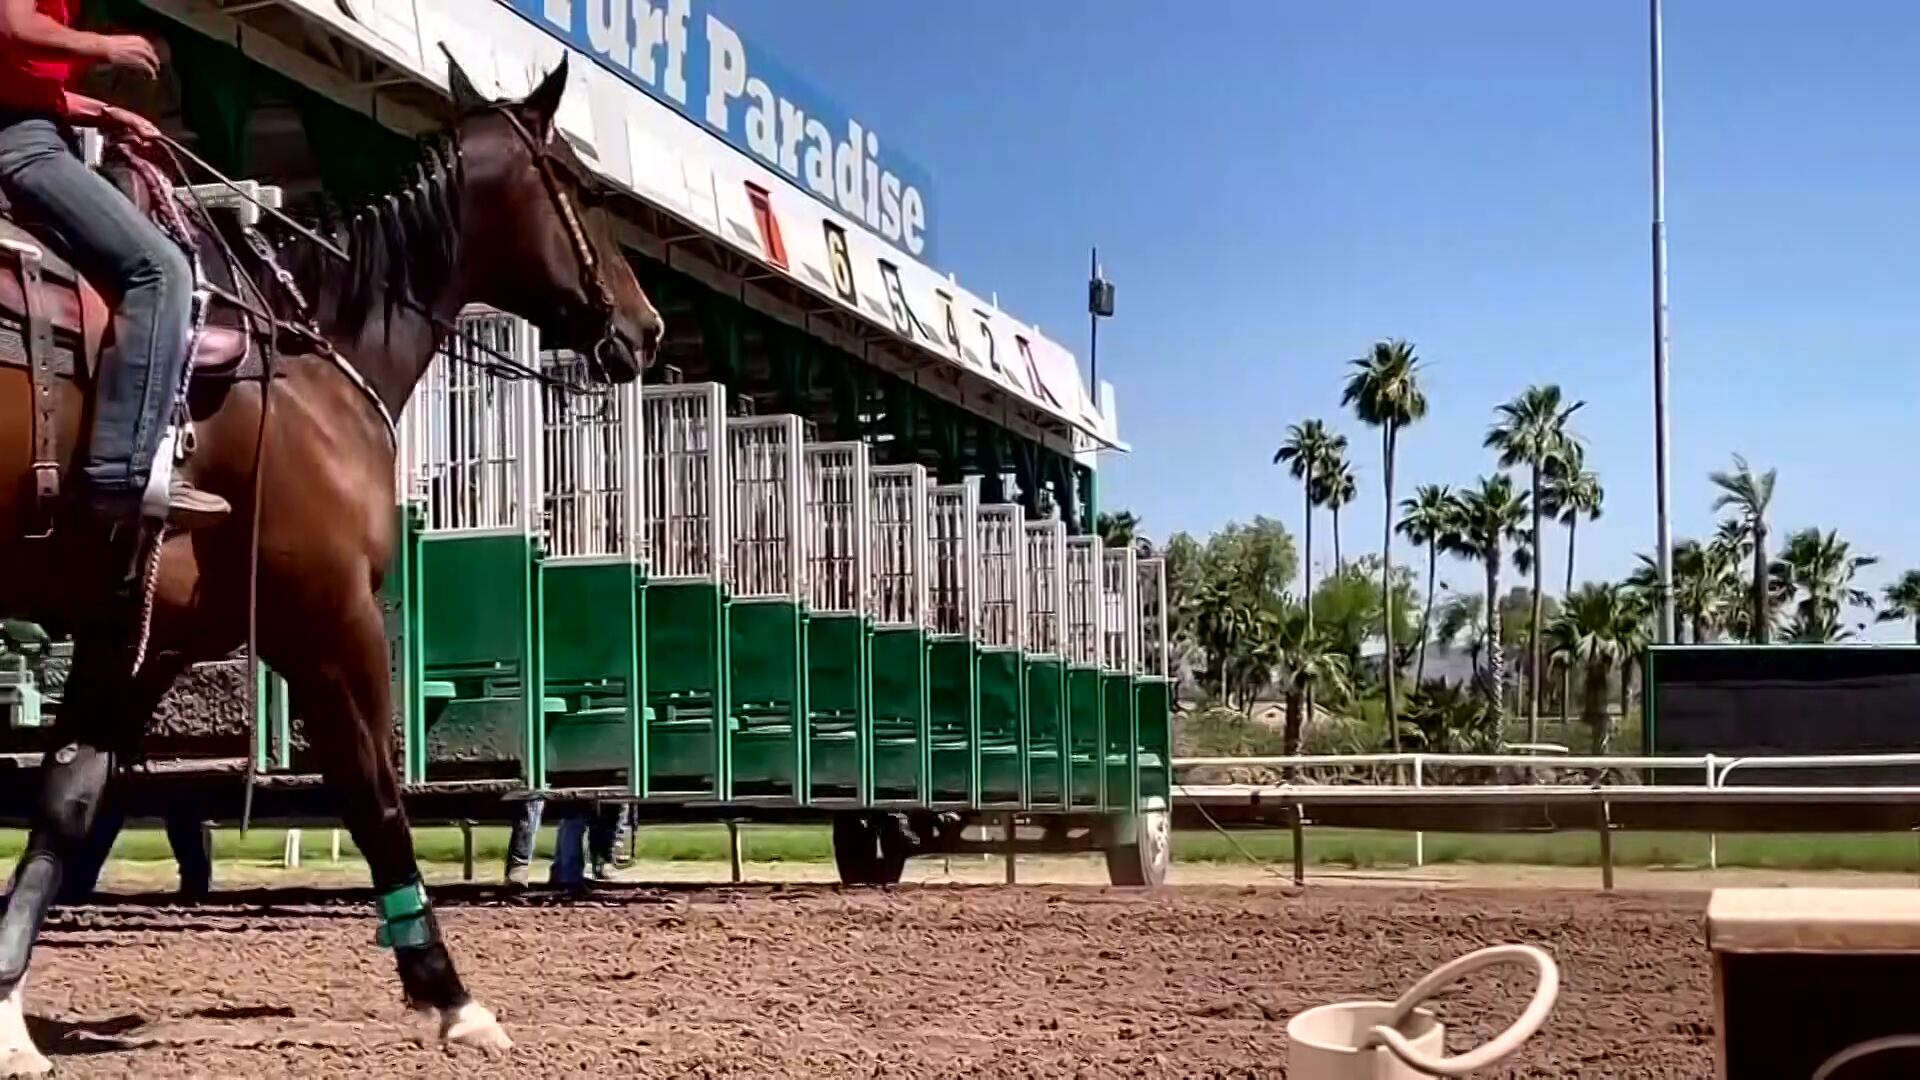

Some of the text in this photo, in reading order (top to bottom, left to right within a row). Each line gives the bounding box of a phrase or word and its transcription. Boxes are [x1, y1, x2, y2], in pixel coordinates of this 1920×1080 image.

[706, 14, 925, 255] Paradise
[827, 228, 853, 299] 6
[881, 266, 910, 336] 5
[944, 304, 962, 359] 4
[979, 320, 1001, 374] 2
